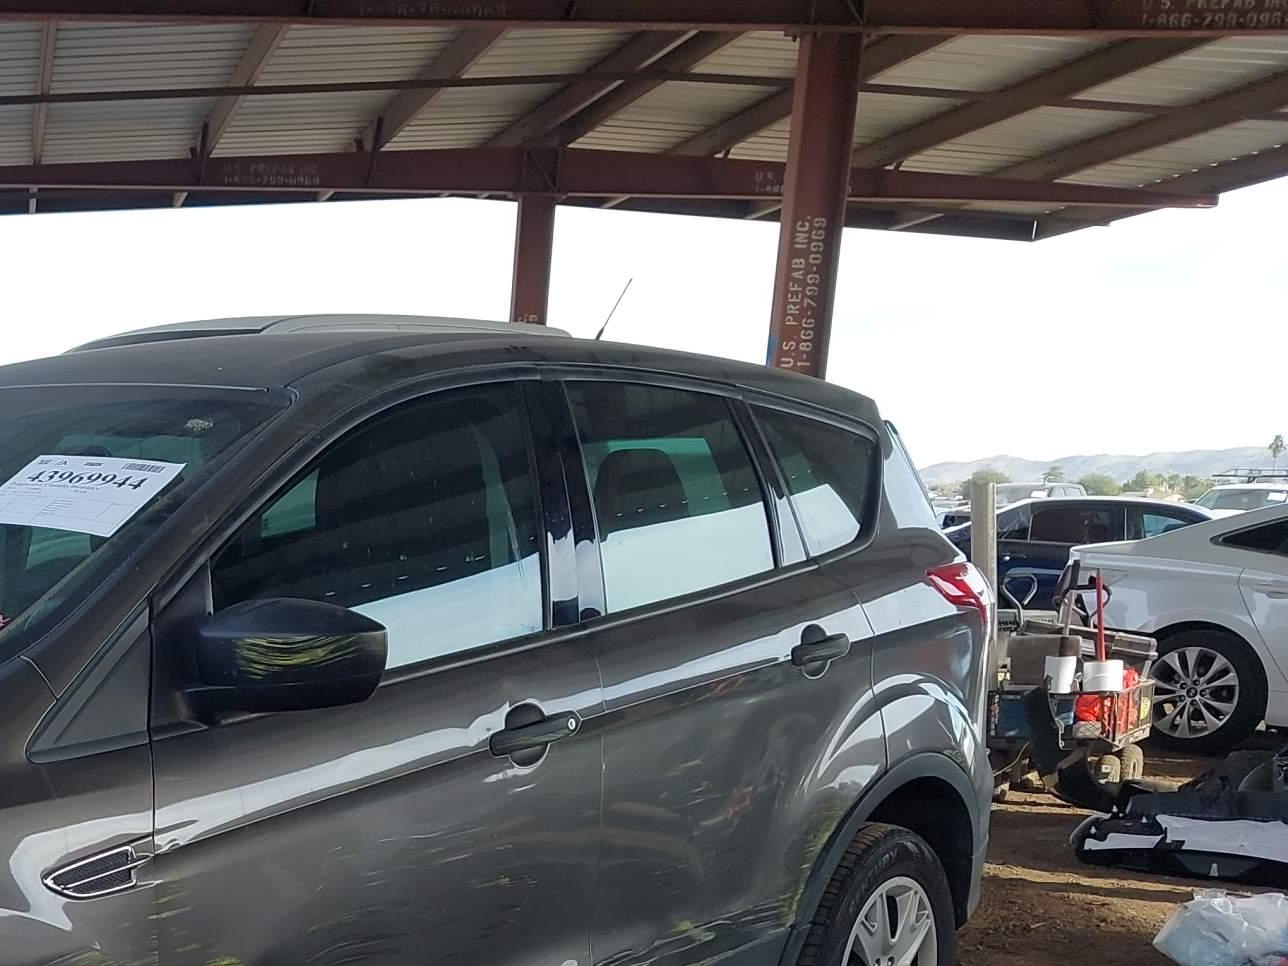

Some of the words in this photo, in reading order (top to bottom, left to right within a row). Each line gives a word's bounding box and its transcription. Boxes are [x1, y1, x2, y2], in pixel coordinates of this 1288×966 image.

[794, 216, 811, 249] INC.
[784, 258, 807, 326] PREFAB
[797, 217, 828, 367] 1-866-799-0969
[779, 335, 798, 369] U.S.
[26, 469, 149, 490] 43969944
